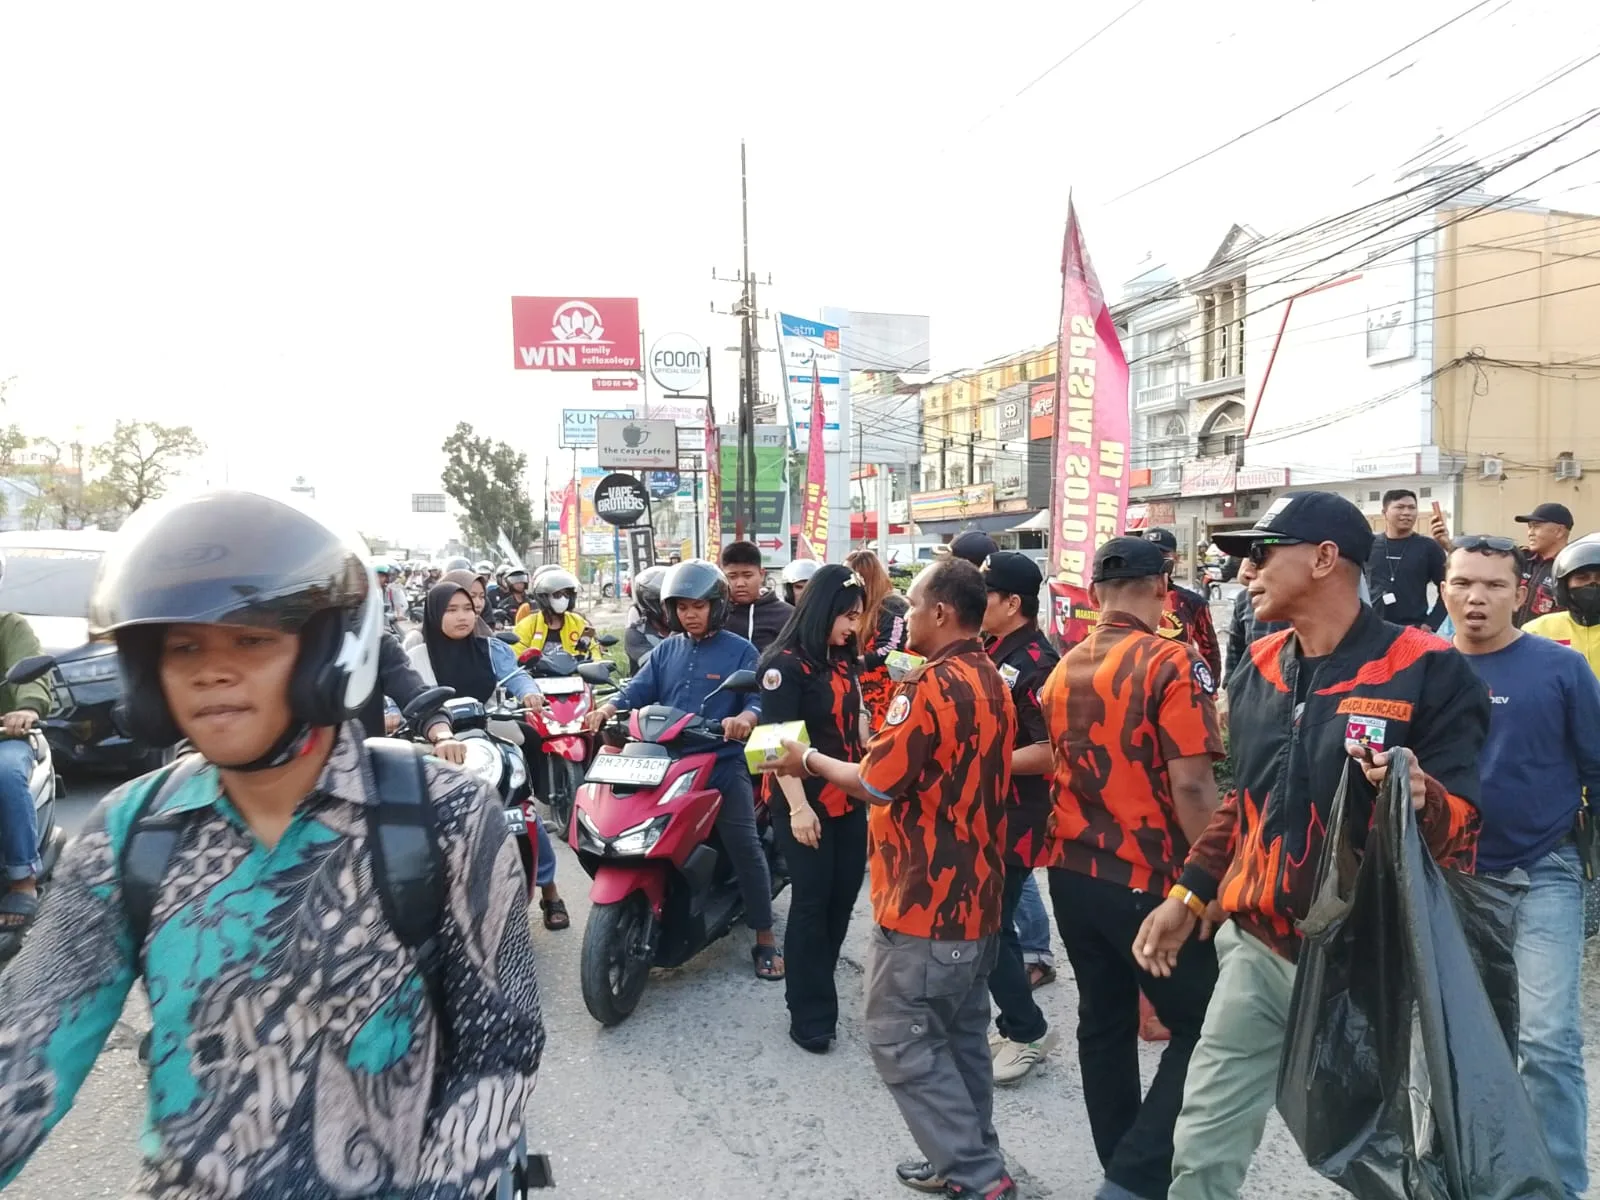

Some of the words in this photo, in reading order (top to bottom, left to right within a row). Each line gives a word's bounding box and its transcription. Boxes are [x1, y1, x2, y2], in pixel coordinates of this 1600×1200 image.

[793, 324, 816, 336] atm
[520, 346, 576, 366] WIN
[581, 345, 611, 356] family
[655, 351, 700, 367] FOOM
[604, 446, 618, 454] the
[608, 486, 634, 498] VAPE
[597, 495, 645, 512] BROTHERS
